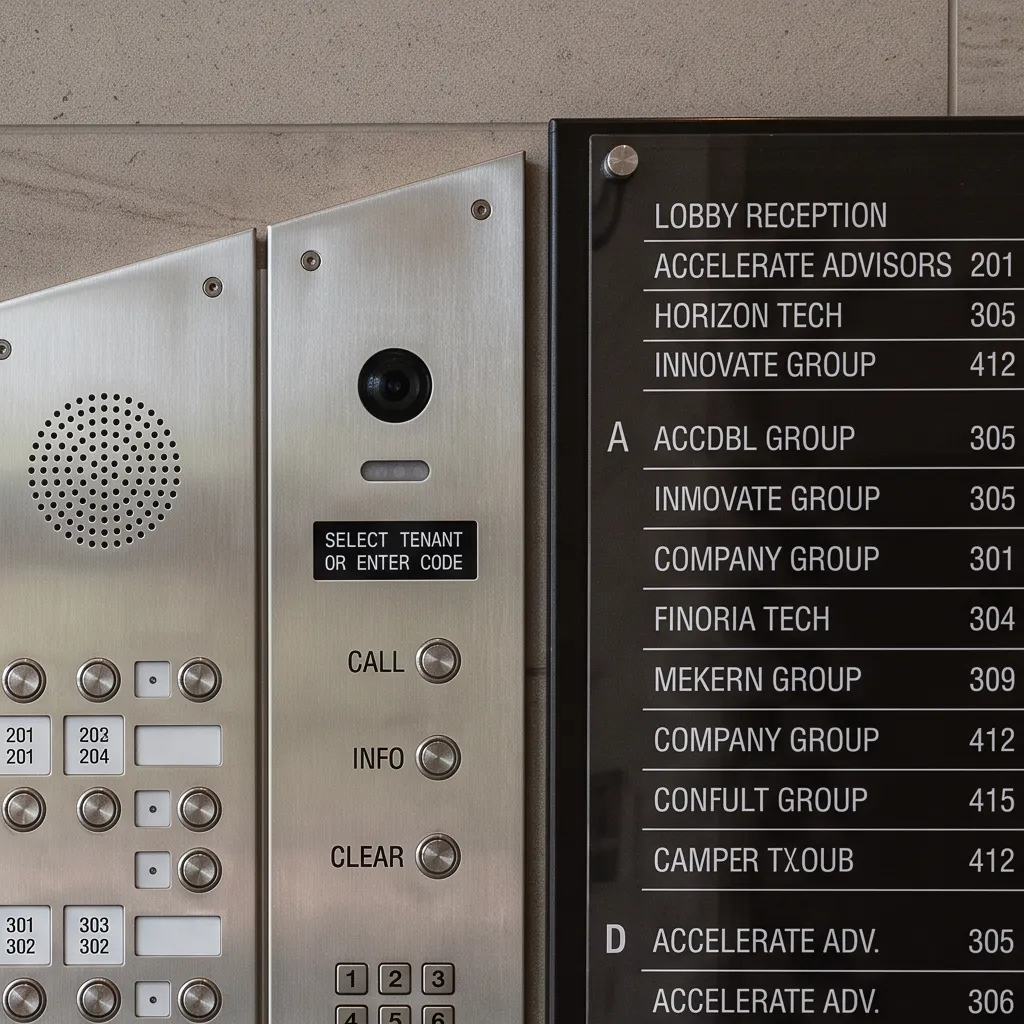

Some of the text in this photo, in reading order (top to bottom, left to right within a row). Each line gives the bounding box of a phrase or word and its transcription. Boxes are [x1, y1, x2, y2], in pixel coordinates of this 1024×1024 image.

[655, 201, 887, 229] LOBBY RECEPTION
[653, 251, 1012, 279] ACCELERATE ADVISORS 201
[655, 301, 1016, 329] HORIZON TECH 305
[655, 351, 1016, 378] INNOVATE GROUP 412
[606, 420, 1016, 453] A ACCDBL GROUP 305
[655, 485, 1016, 512] INMOVATE GROUP 305
[325, 531, 463, 548] SELECT TENANT
[325, 554, 463, 571] OR ENTER CODE
[654, 545, 1012, 572] COMPANY GROUP 301
[655, 605, 1016, 632] FINORIA TECH 304
[348, 650, 405, 674] CALL
[654, 666, 1015, 692] MEKERN GROUP 309
[6, 726, 33, 743] 201
[654, 726, 1015, 753] COMPANY GROUP 412
[6, 748, 33, 765] 201
[79, 748, 110, 765] 204
[353, 746, 404, 770] INFO
[654, 786, 1015, 813] CONFULT GROUP 415
[331, 845, 404, 868] CLEAR
[654, 846, 759, 873] CAMPER
[968, 847, 1015, 873] 412
[6, 916, 33, 933] 301
[79, 916, 110, 934] 303
[6, 938, 36, 955] 302
[79, 938, 110, 955] 302
[606, 923, 1014, 954] D ACCELERATE ADV. 305
[388, 969, 403, 988] 2
[431, 969, 446, 989] 3
[652, 987, 1014, 1014] ACCELERATE ADV. 306
